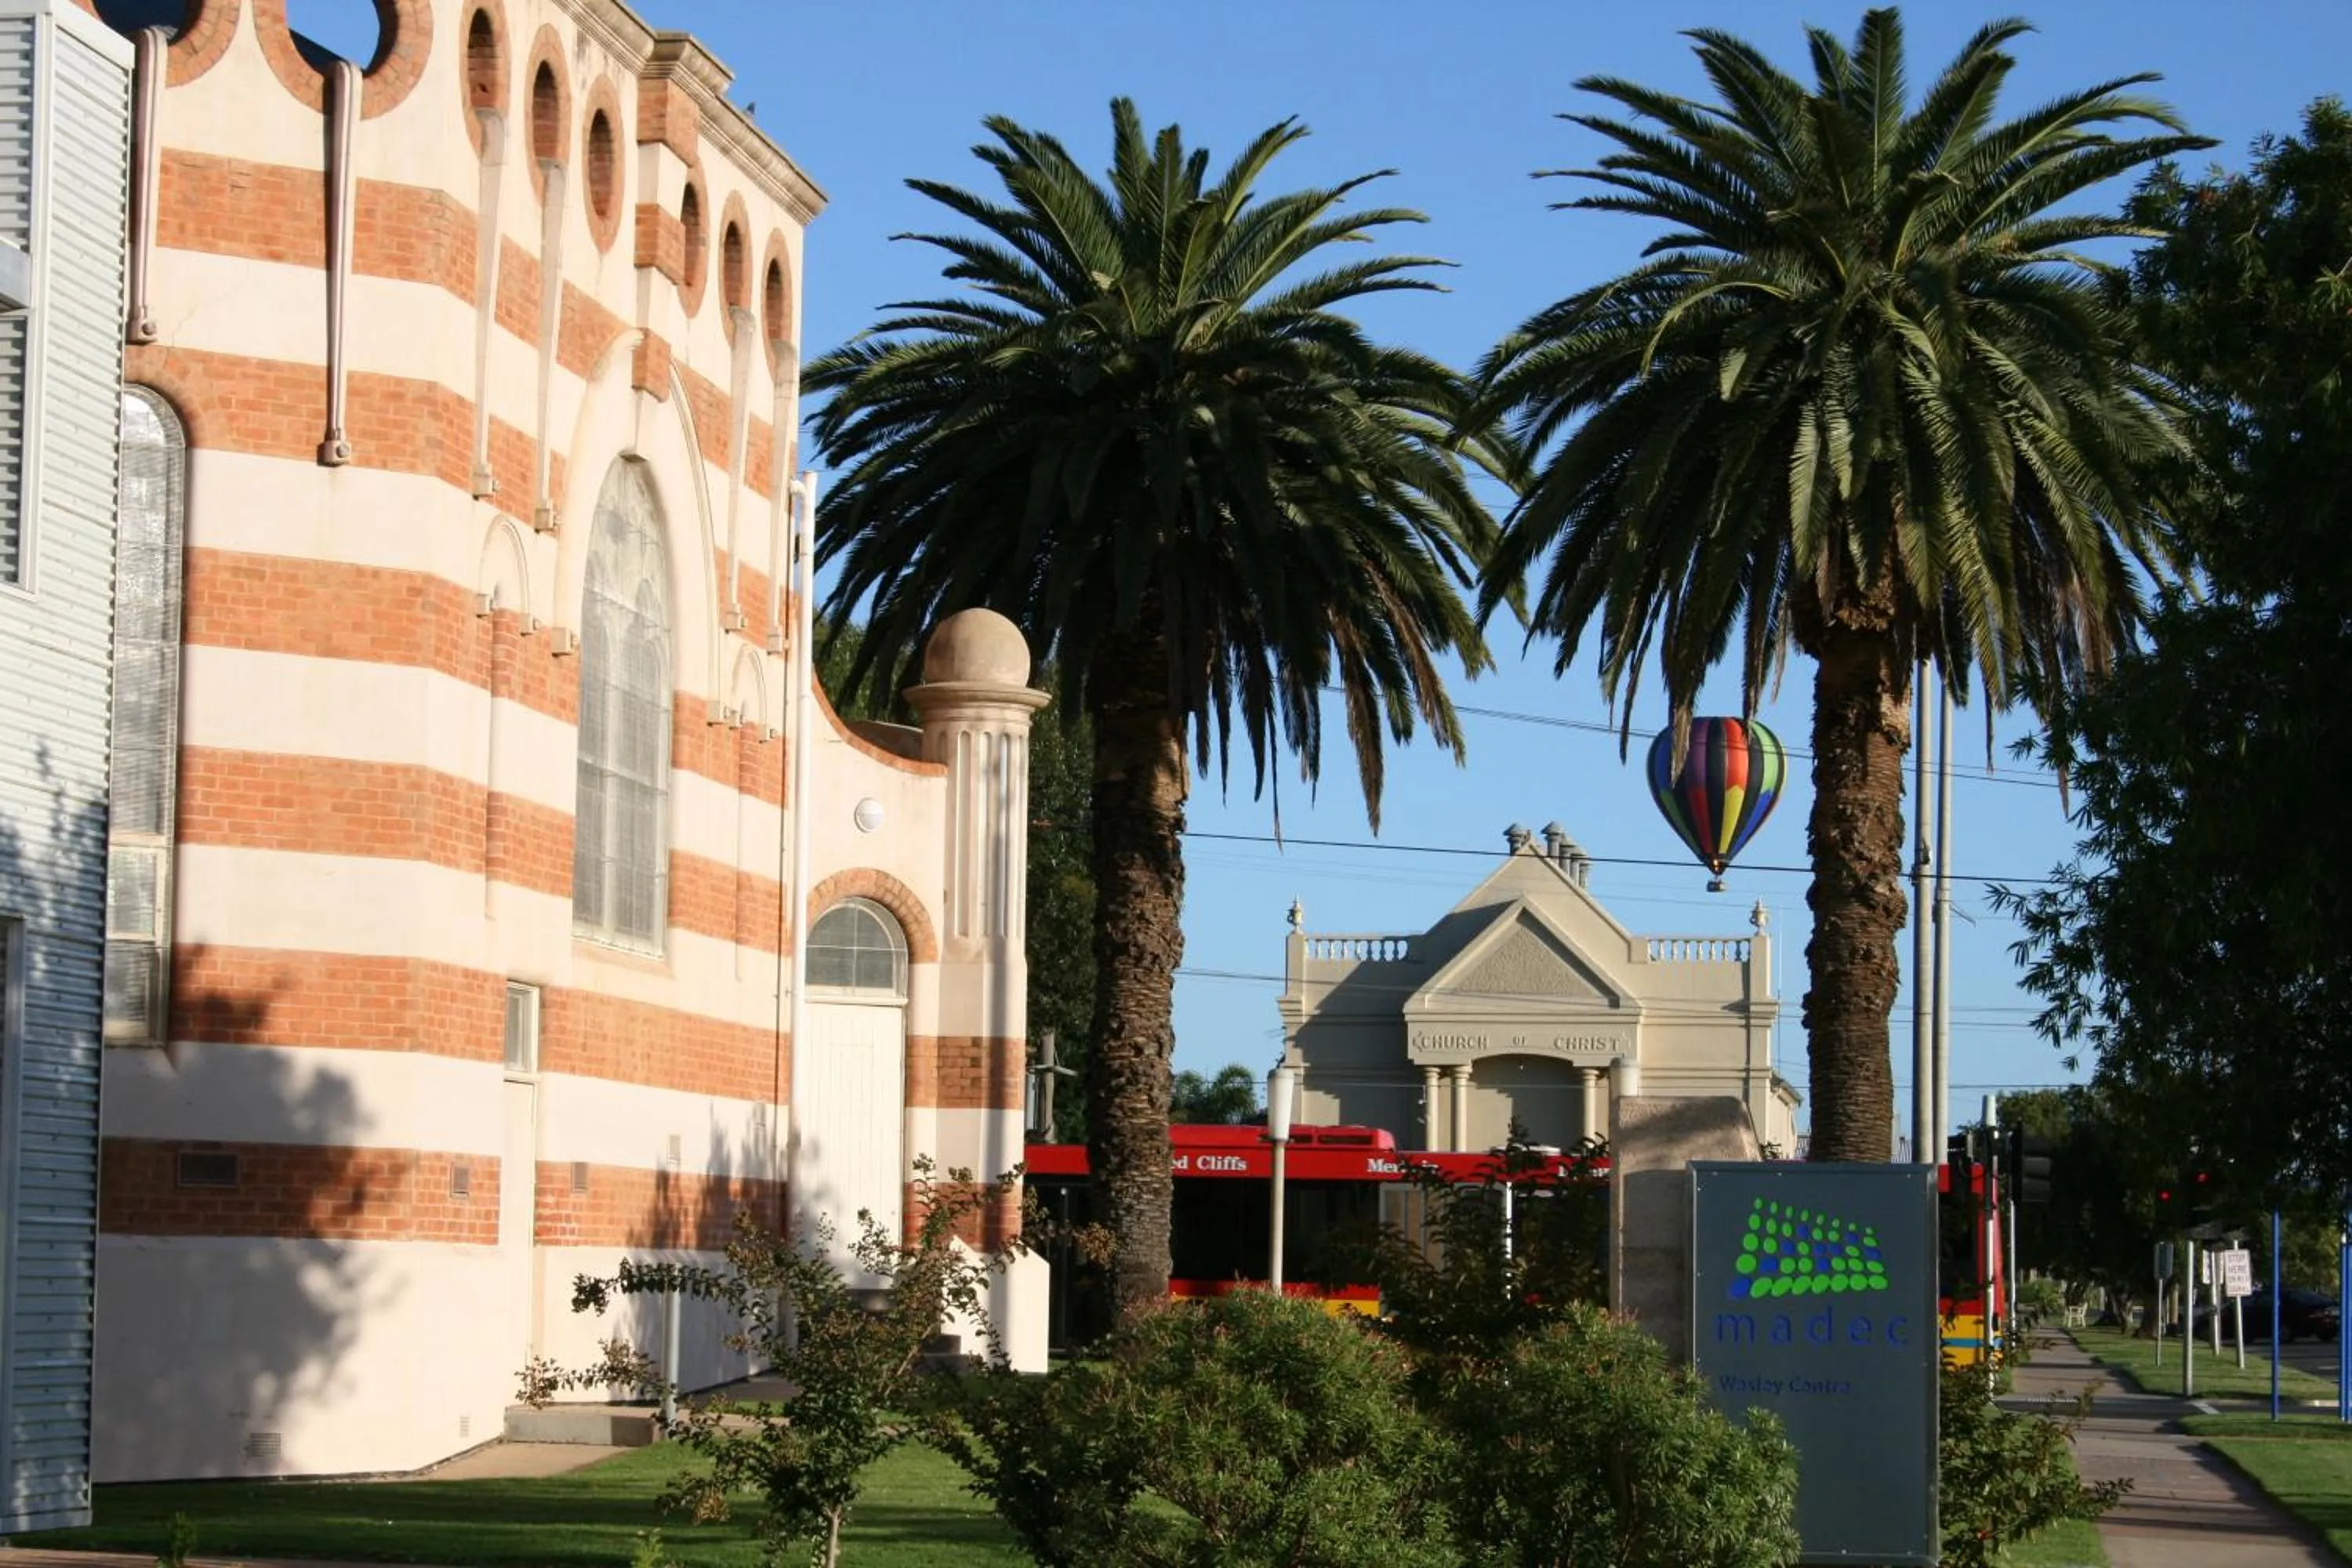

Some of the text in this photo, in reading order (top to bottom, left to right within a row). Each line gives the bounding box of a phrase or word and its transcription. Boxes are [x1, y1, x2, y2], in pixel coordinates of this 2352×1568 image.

[1420, 1034, 1488, 1051] CHURCH
[1552, 1036, 1621, 1052] CHRIST
[1196, 1155, 1247, 1171] Cliffs
[1716, 1305, 1908, 1346] madec
